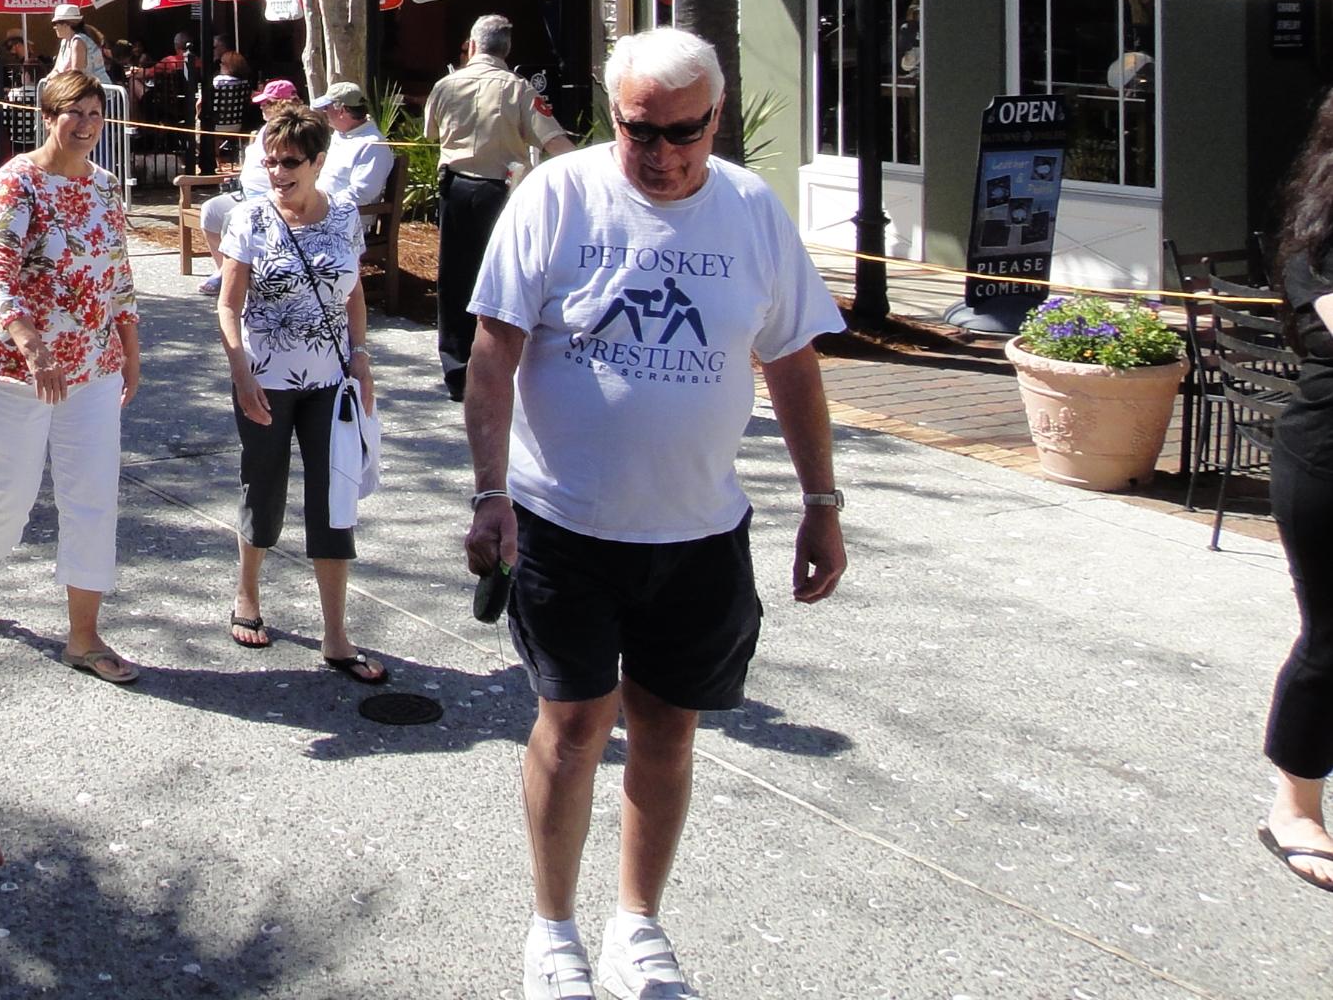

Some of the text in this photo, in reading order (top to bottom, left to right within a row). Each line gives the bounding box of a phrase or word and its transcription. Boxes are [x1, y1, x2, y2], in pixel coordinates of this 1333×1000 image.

[998, 100, 1056, 125] OPEN
[578, 244, 735, 279] PETOSKEY
[976, 258, 1044, 275] PLEASE
[975, 282, 1020, 298] COME
[565, 351, 722, 384] GOLF SCRAMBLE
[569, 333, 727, 373] WRESTLING
